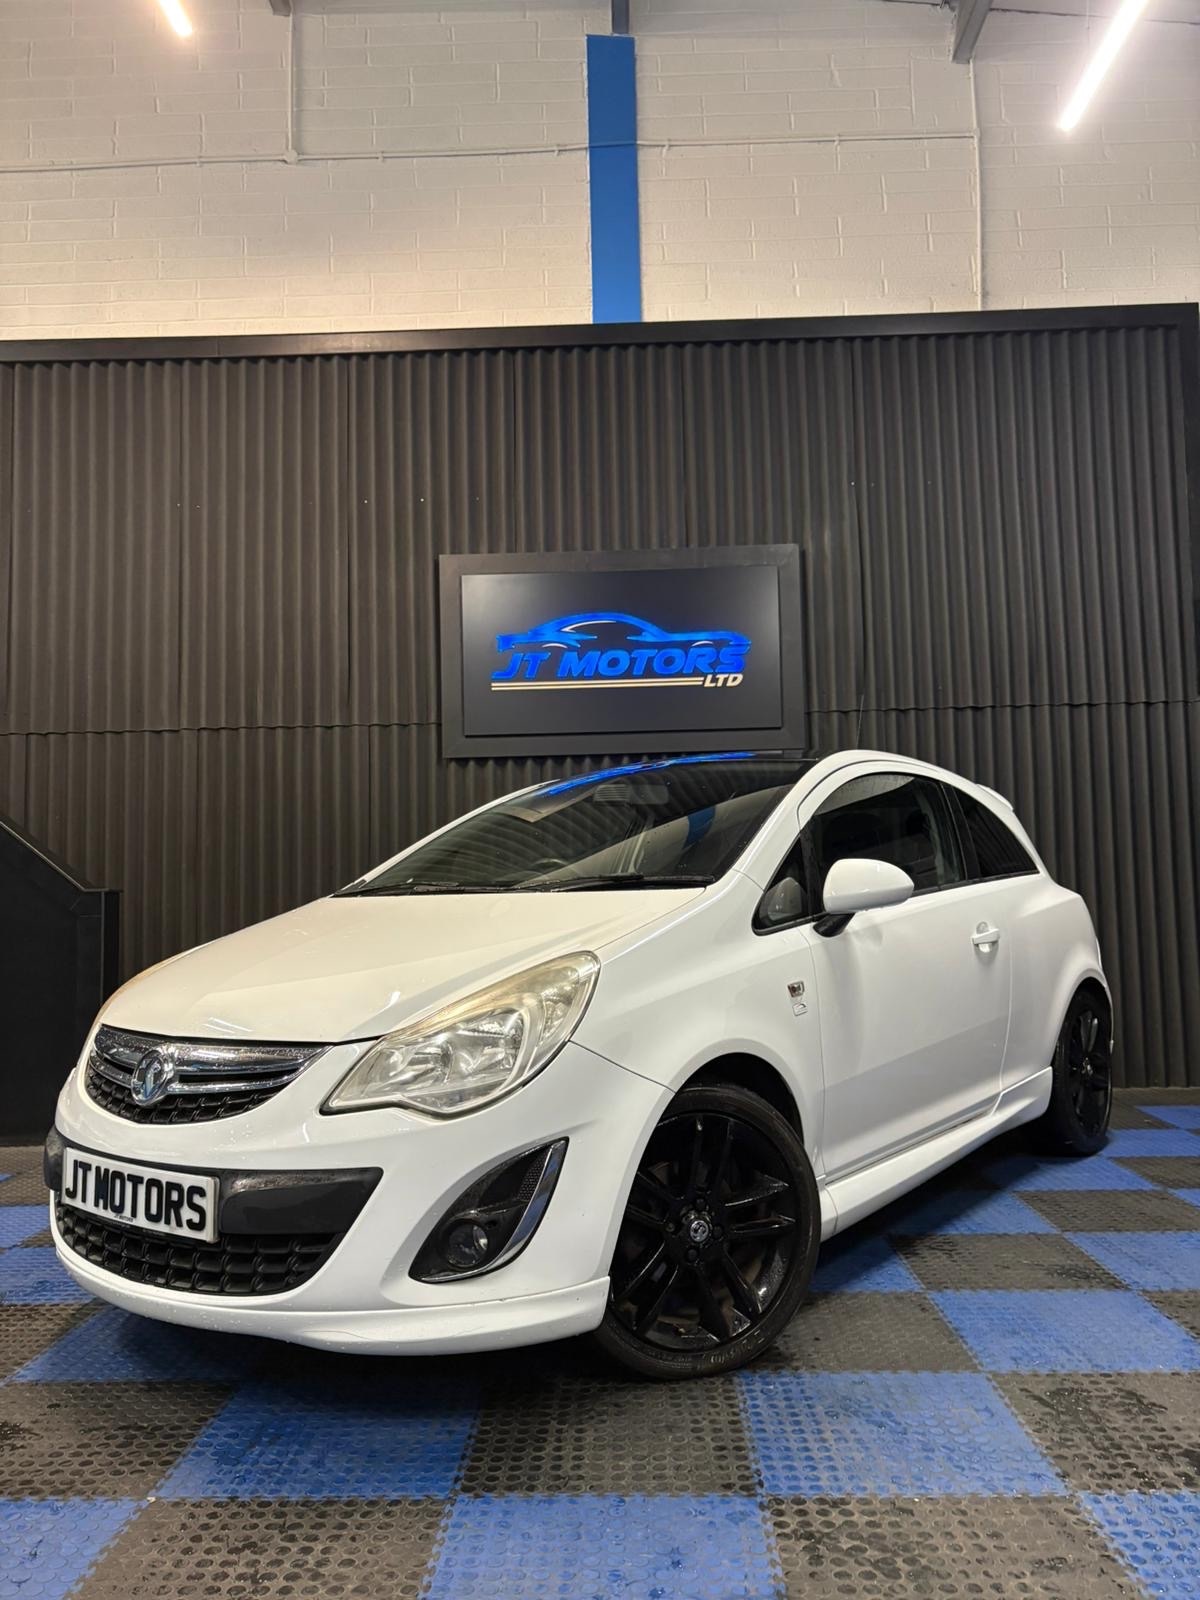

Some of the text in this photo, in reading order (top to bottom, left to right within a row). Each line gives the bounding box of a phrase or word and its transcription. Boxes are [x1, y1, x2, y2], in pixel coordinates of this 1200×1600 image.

[491, 646, 750, 681] JT MOTORS
[703, 673, 743, 688] LTD
[65, 1159, 207, 1232] JT MOTORS
